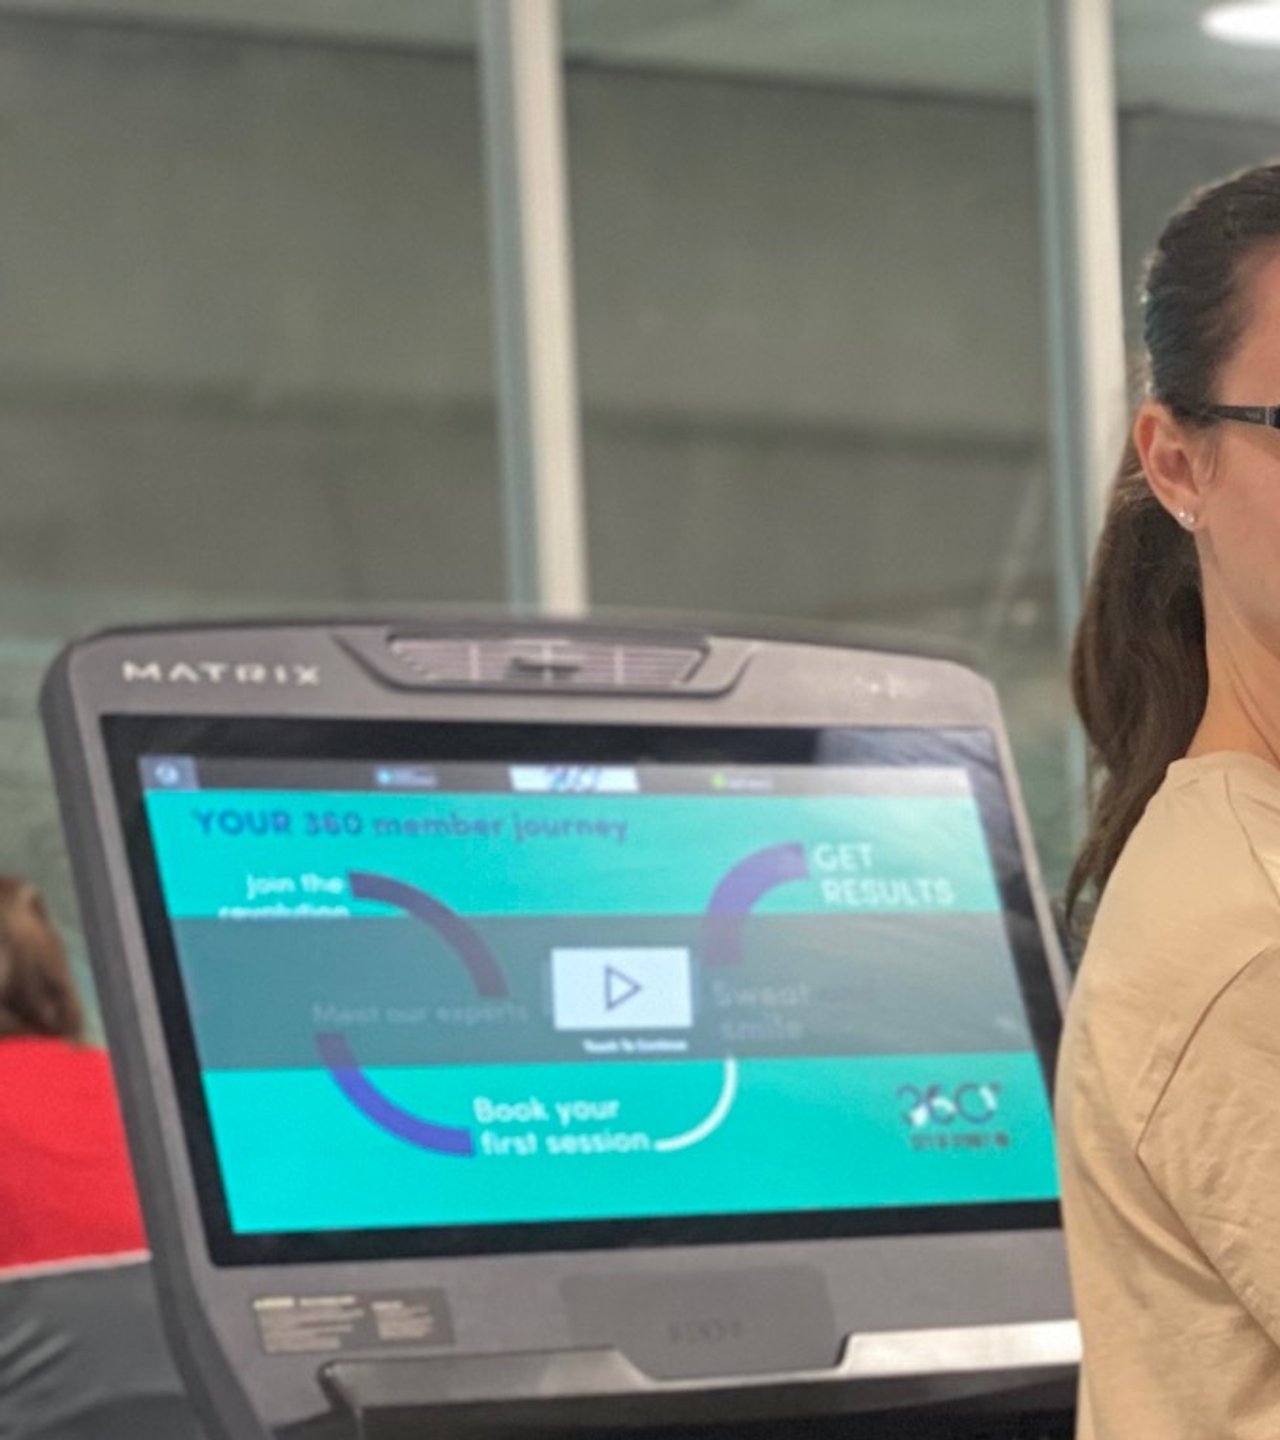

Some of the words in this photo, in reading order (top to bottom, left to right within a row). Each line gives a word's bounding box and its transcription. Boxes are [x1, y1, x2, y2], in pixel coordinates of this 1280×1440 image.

[123, 661, 320, 686] MATRIX
[193, 809, 293, 836] YOUR
[304, 811, 364, 837] 360
[372, 809, 502, 837] member
[511, 811, 628, 845] journey
[812, 842, 874, 872] GET
[300, 872, 344, 894] the
[821, 877, 957, 907] RESULTS
[473, 1096, 547, 1125] Book
[554, 1099, 620, 1129] your
[480, 1127, 538, 1157] first
[545, 1129, 652, 1155] session
